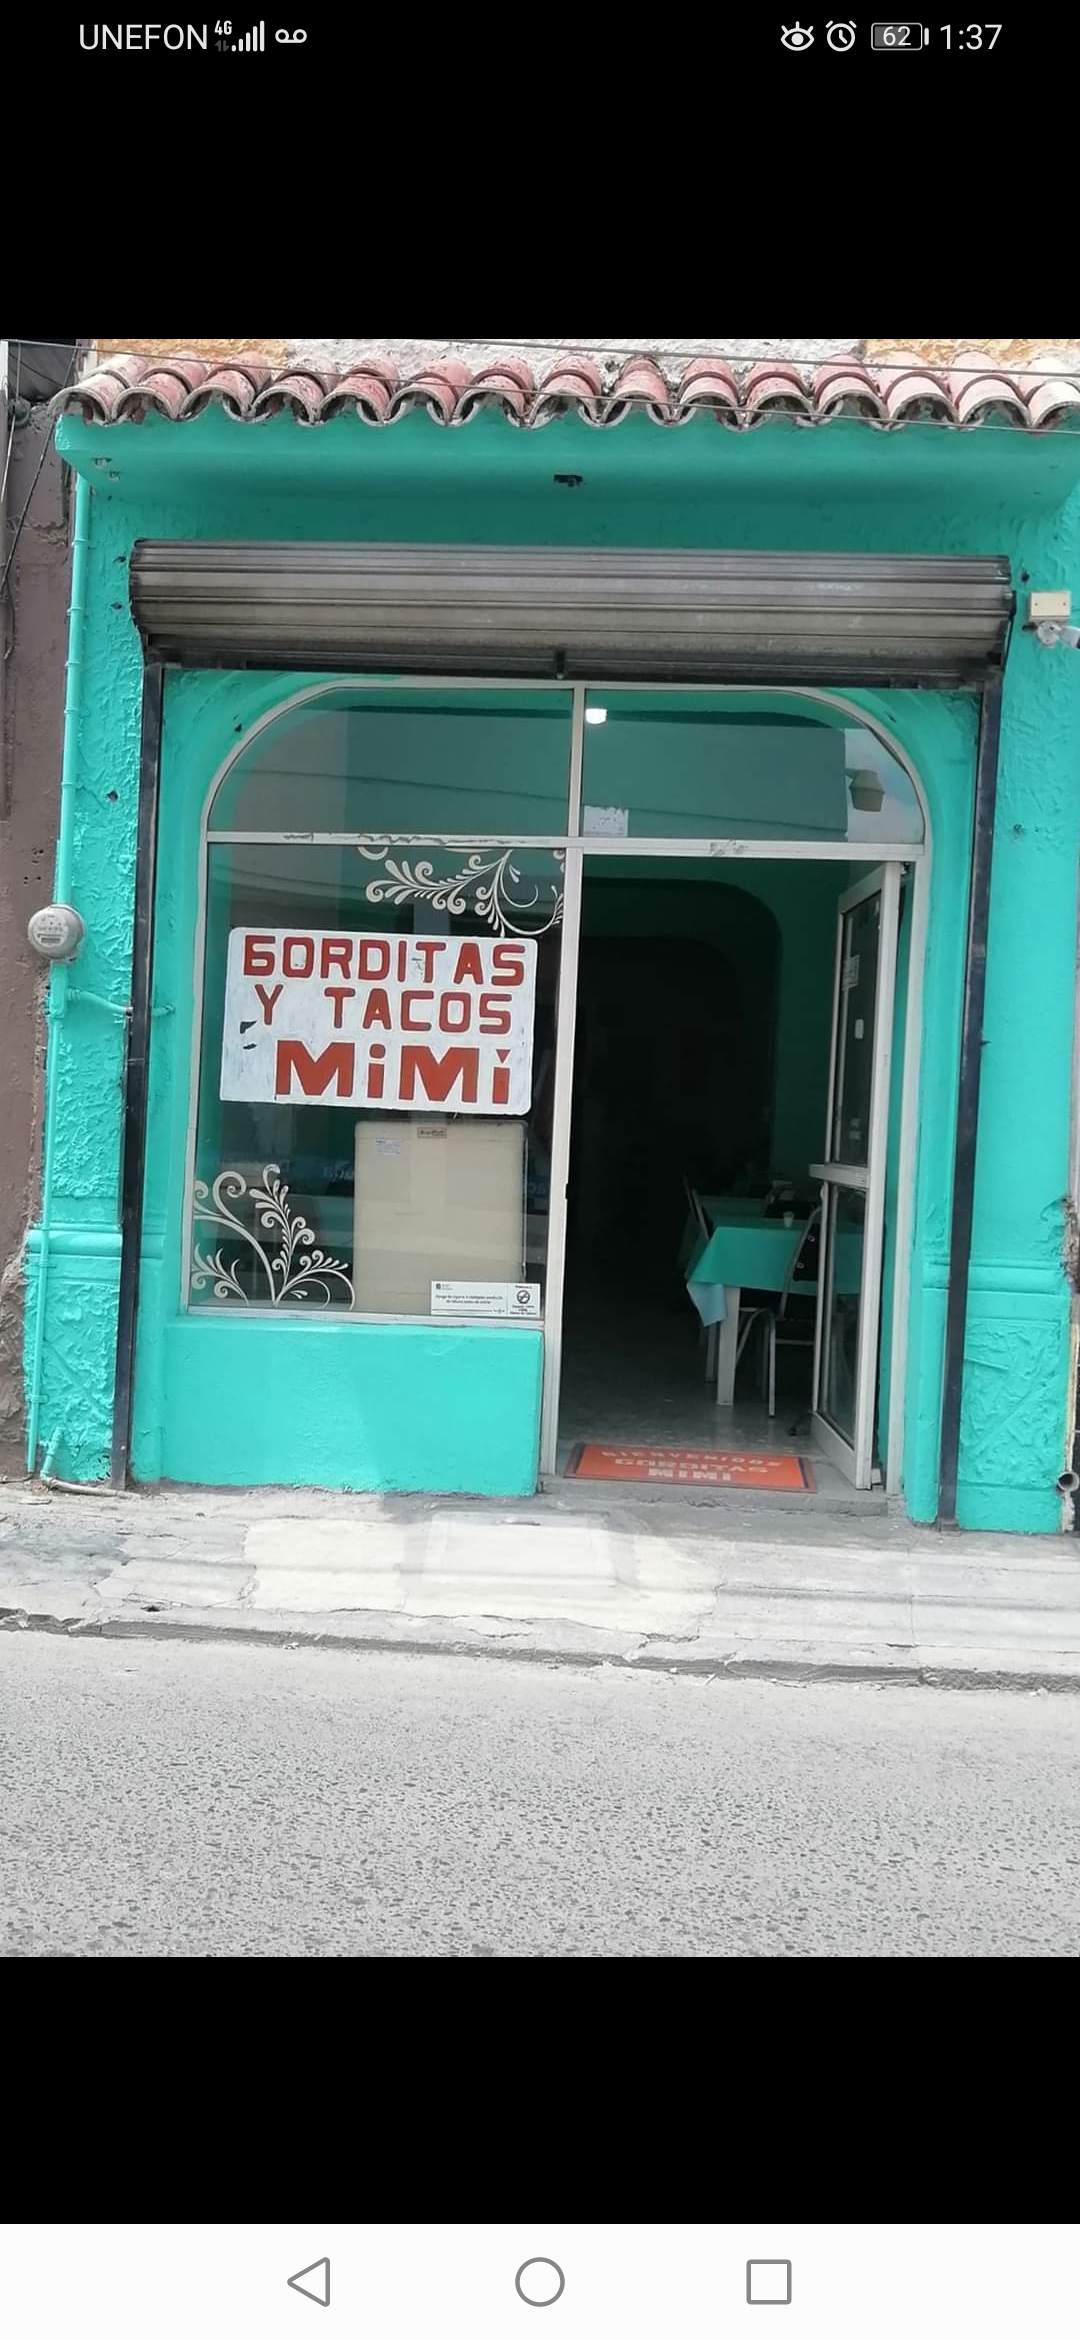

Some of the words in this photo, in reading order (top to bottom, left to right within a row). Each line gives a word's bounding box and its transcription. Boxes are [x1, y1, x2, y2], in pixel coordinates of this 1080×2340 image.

[254, 983, 284, 1026] Y
[324, 987, 513, 1034] TACOS
[614, 1459, 769, 1473] GORDITAS
[648, 1467, 731, 1481] MIMI
